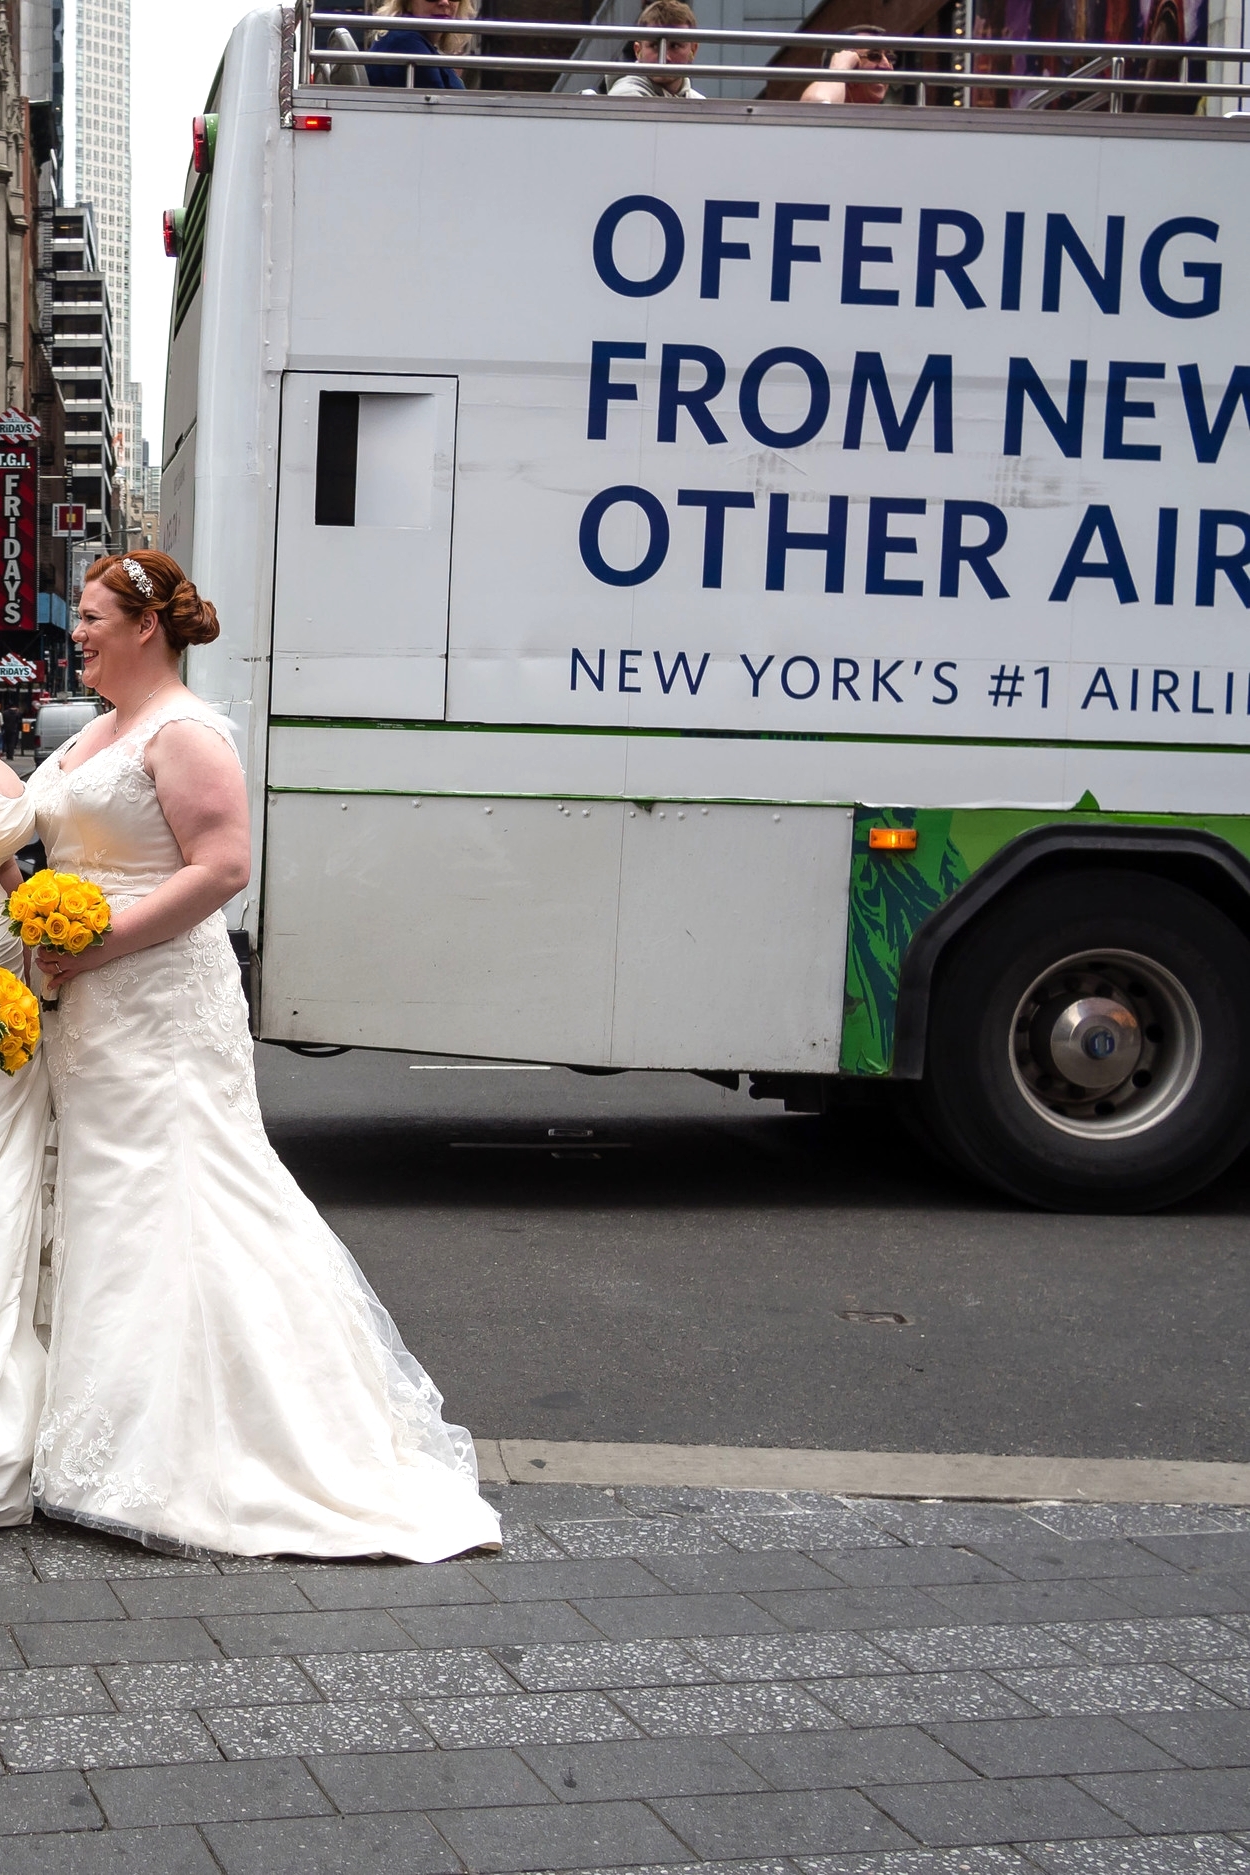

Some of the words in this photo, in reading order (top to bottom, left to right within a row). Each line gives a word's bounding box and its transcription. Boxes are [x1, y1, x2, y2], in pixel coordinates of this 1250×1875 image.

[592, 194, 1223, 319] OFFERING
[587, 340, 953, 455] FROM
[1002, 356, 1250, 464] NEW
[578, 485, 1010, 600] OTHER
[1047, 504, 1250, 608] AIR
[569, 647, 711, 696] NEW
[740, 654, 960, 705] YORK'S
[988, 664, 1051, 709] #1
[1081, 666, 1250, 716] AIRLI
